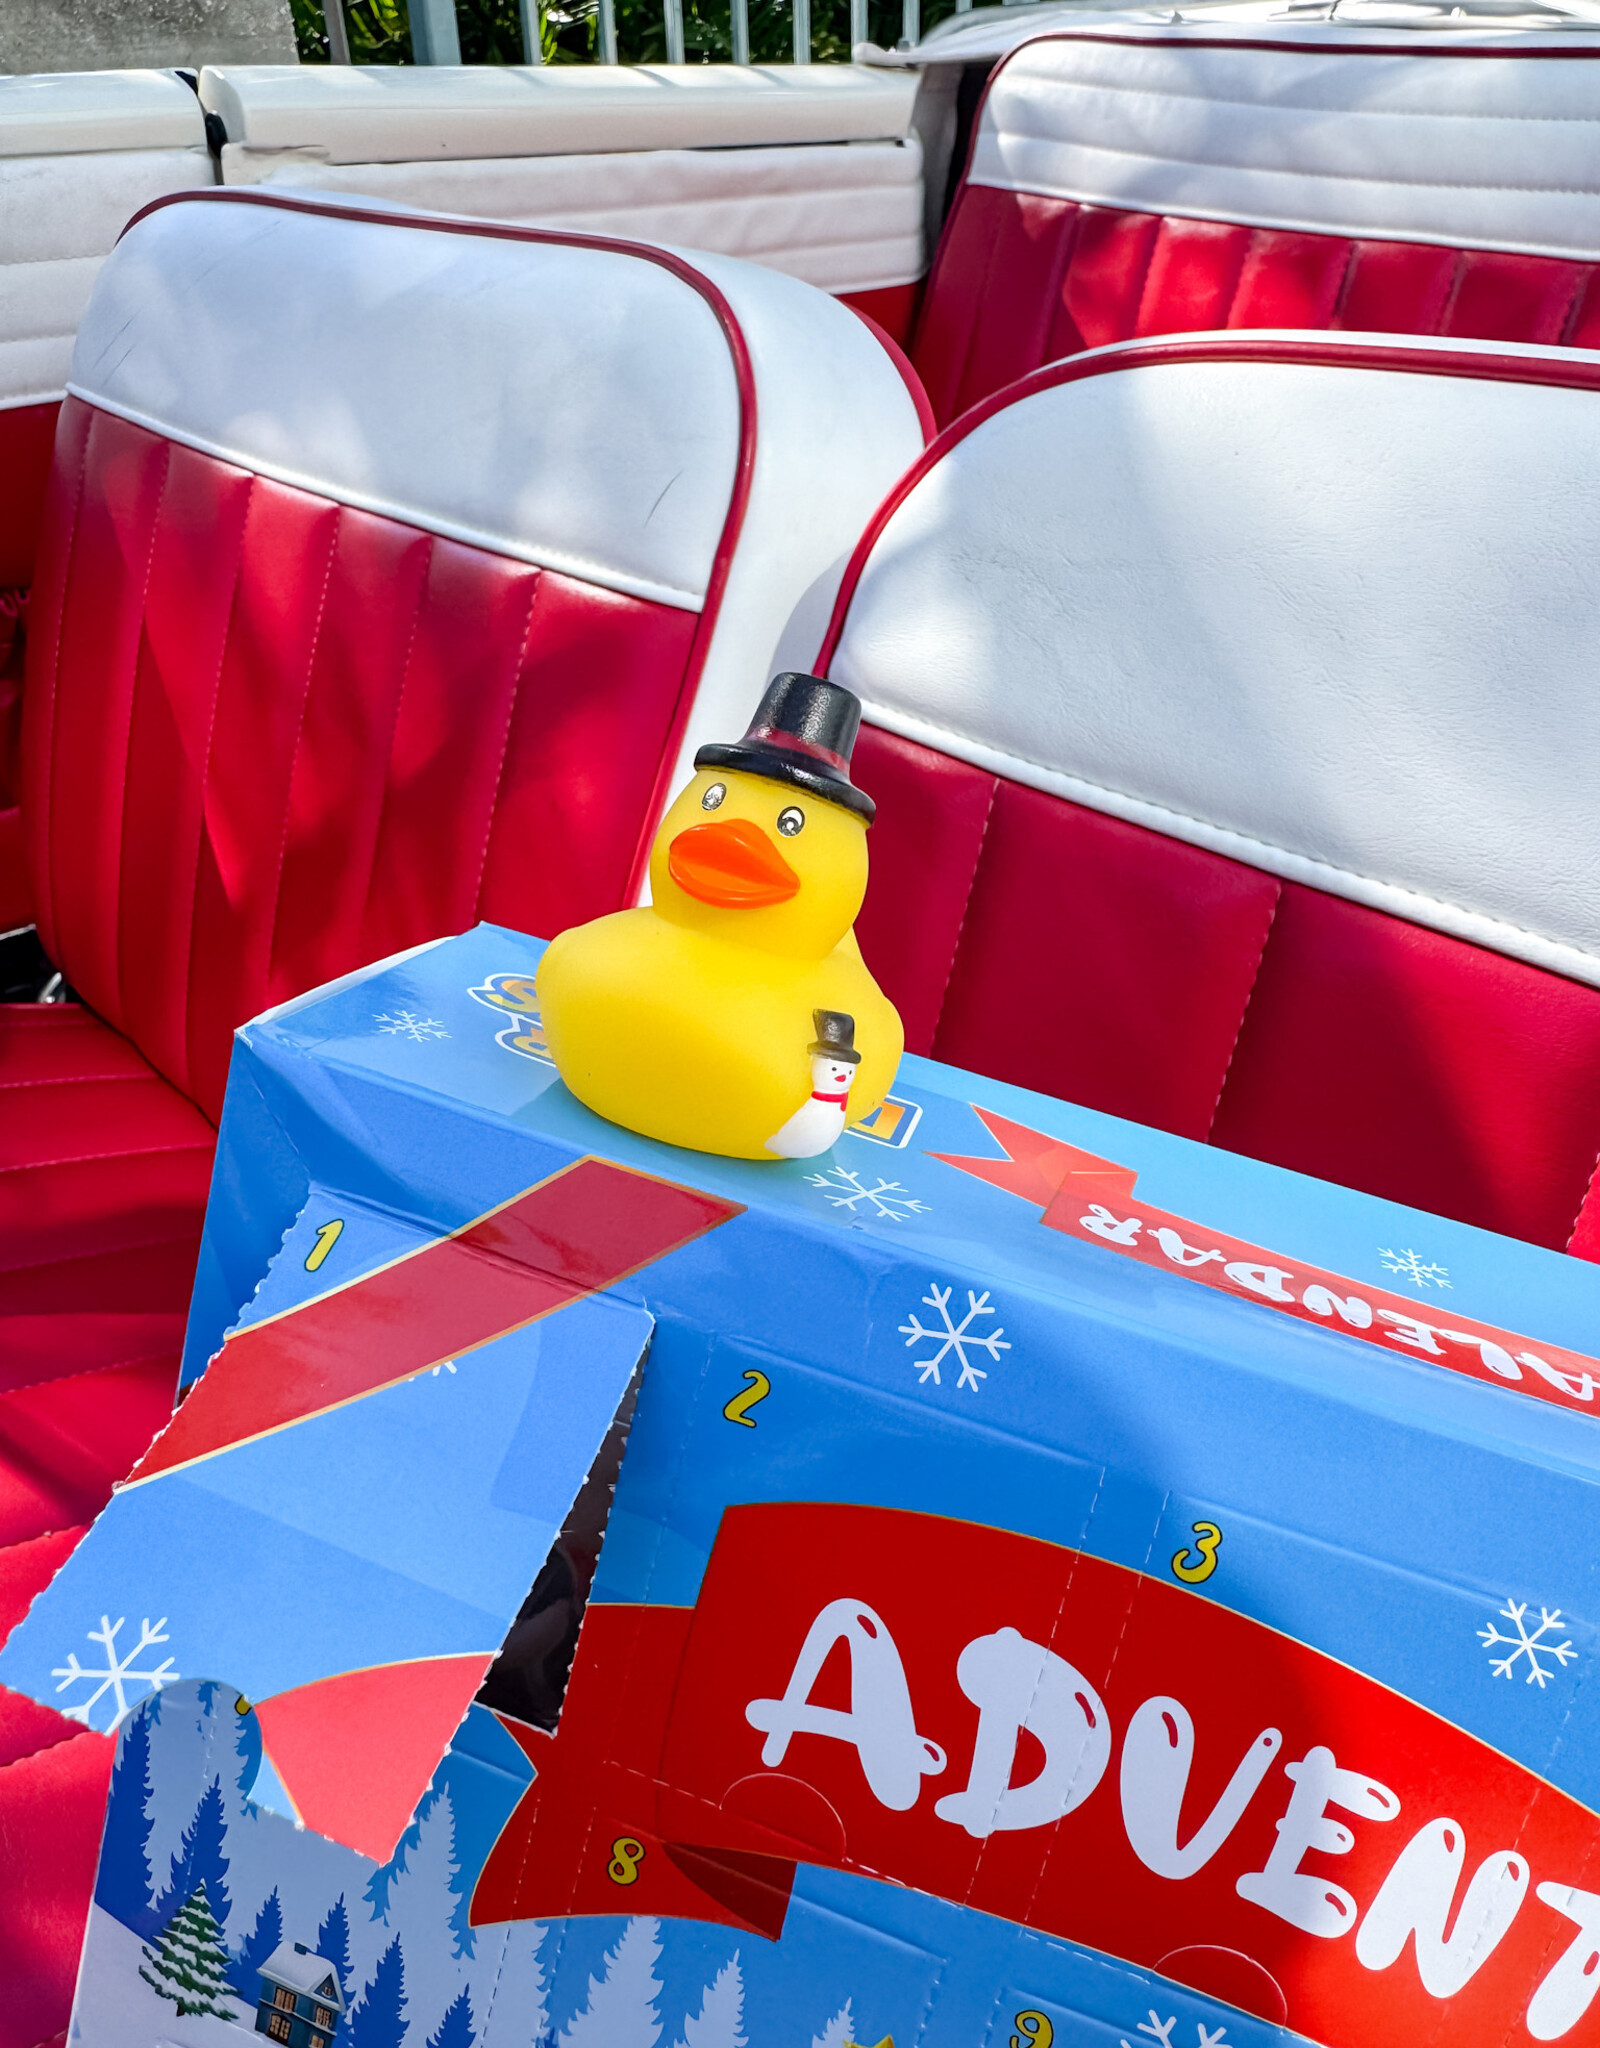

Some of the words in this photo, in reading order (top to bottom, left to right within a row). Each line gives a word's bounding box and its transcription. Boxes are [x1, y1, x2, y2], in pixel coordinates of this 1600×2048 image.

[304, 1218, 344, 1273] 1
[723, 1369, 771, 1428] 2
[1171, 1520, 1223, 1585] 3
[607, 1836, 646, 1886] 8
[1009, 2009, 1054, 2048] 9
